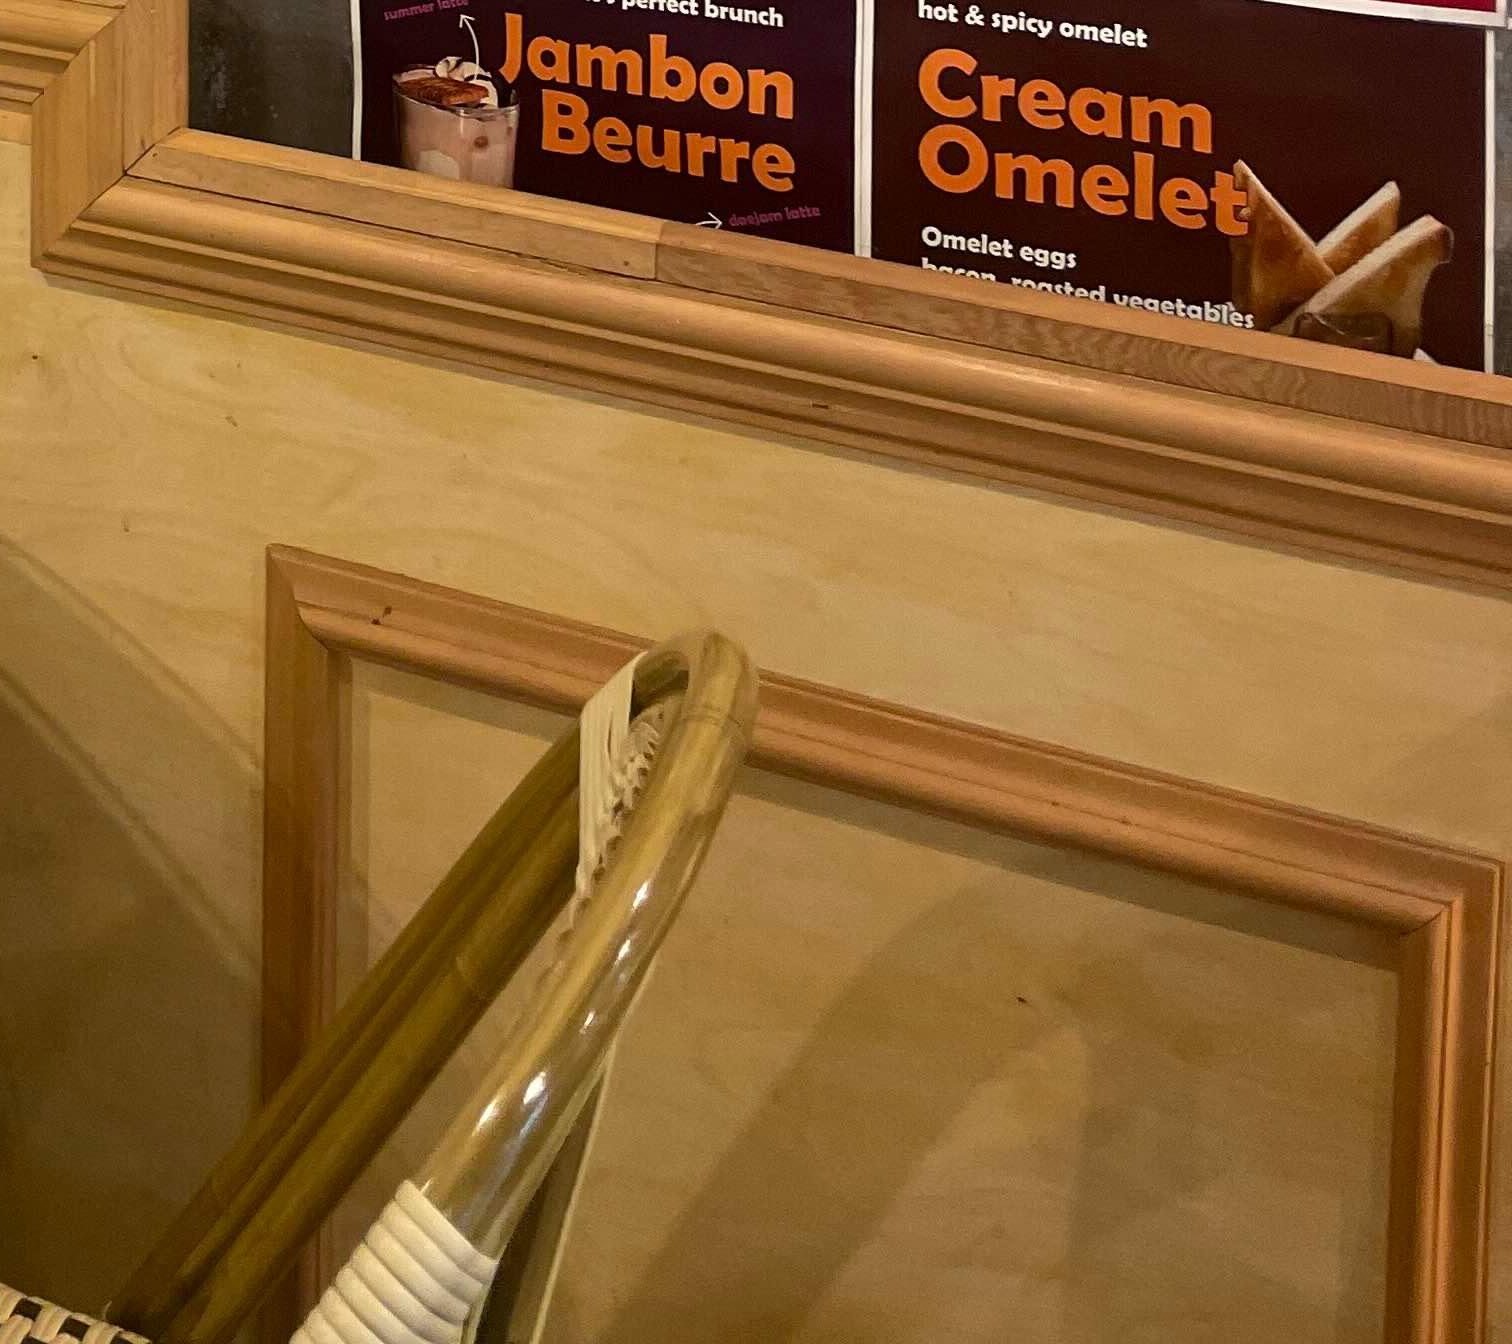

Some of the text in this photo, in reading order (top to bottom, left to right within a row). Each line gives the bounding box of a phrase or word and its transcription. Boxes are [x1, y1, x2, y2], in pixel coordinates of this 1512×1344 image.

[498, 11, 796, 120] Jambon
[964, 4, 986, 28] &
[990, 11, 1054, 39] spicy
[1059, 18, 1148, 49] omelet
[540, 88, 797, 193] Beurre
[917, 47, 1214, 155] Cream
[917, 123, 1250, 237] Omelet
[921, 225, 1077, 270] Omelet eggs
